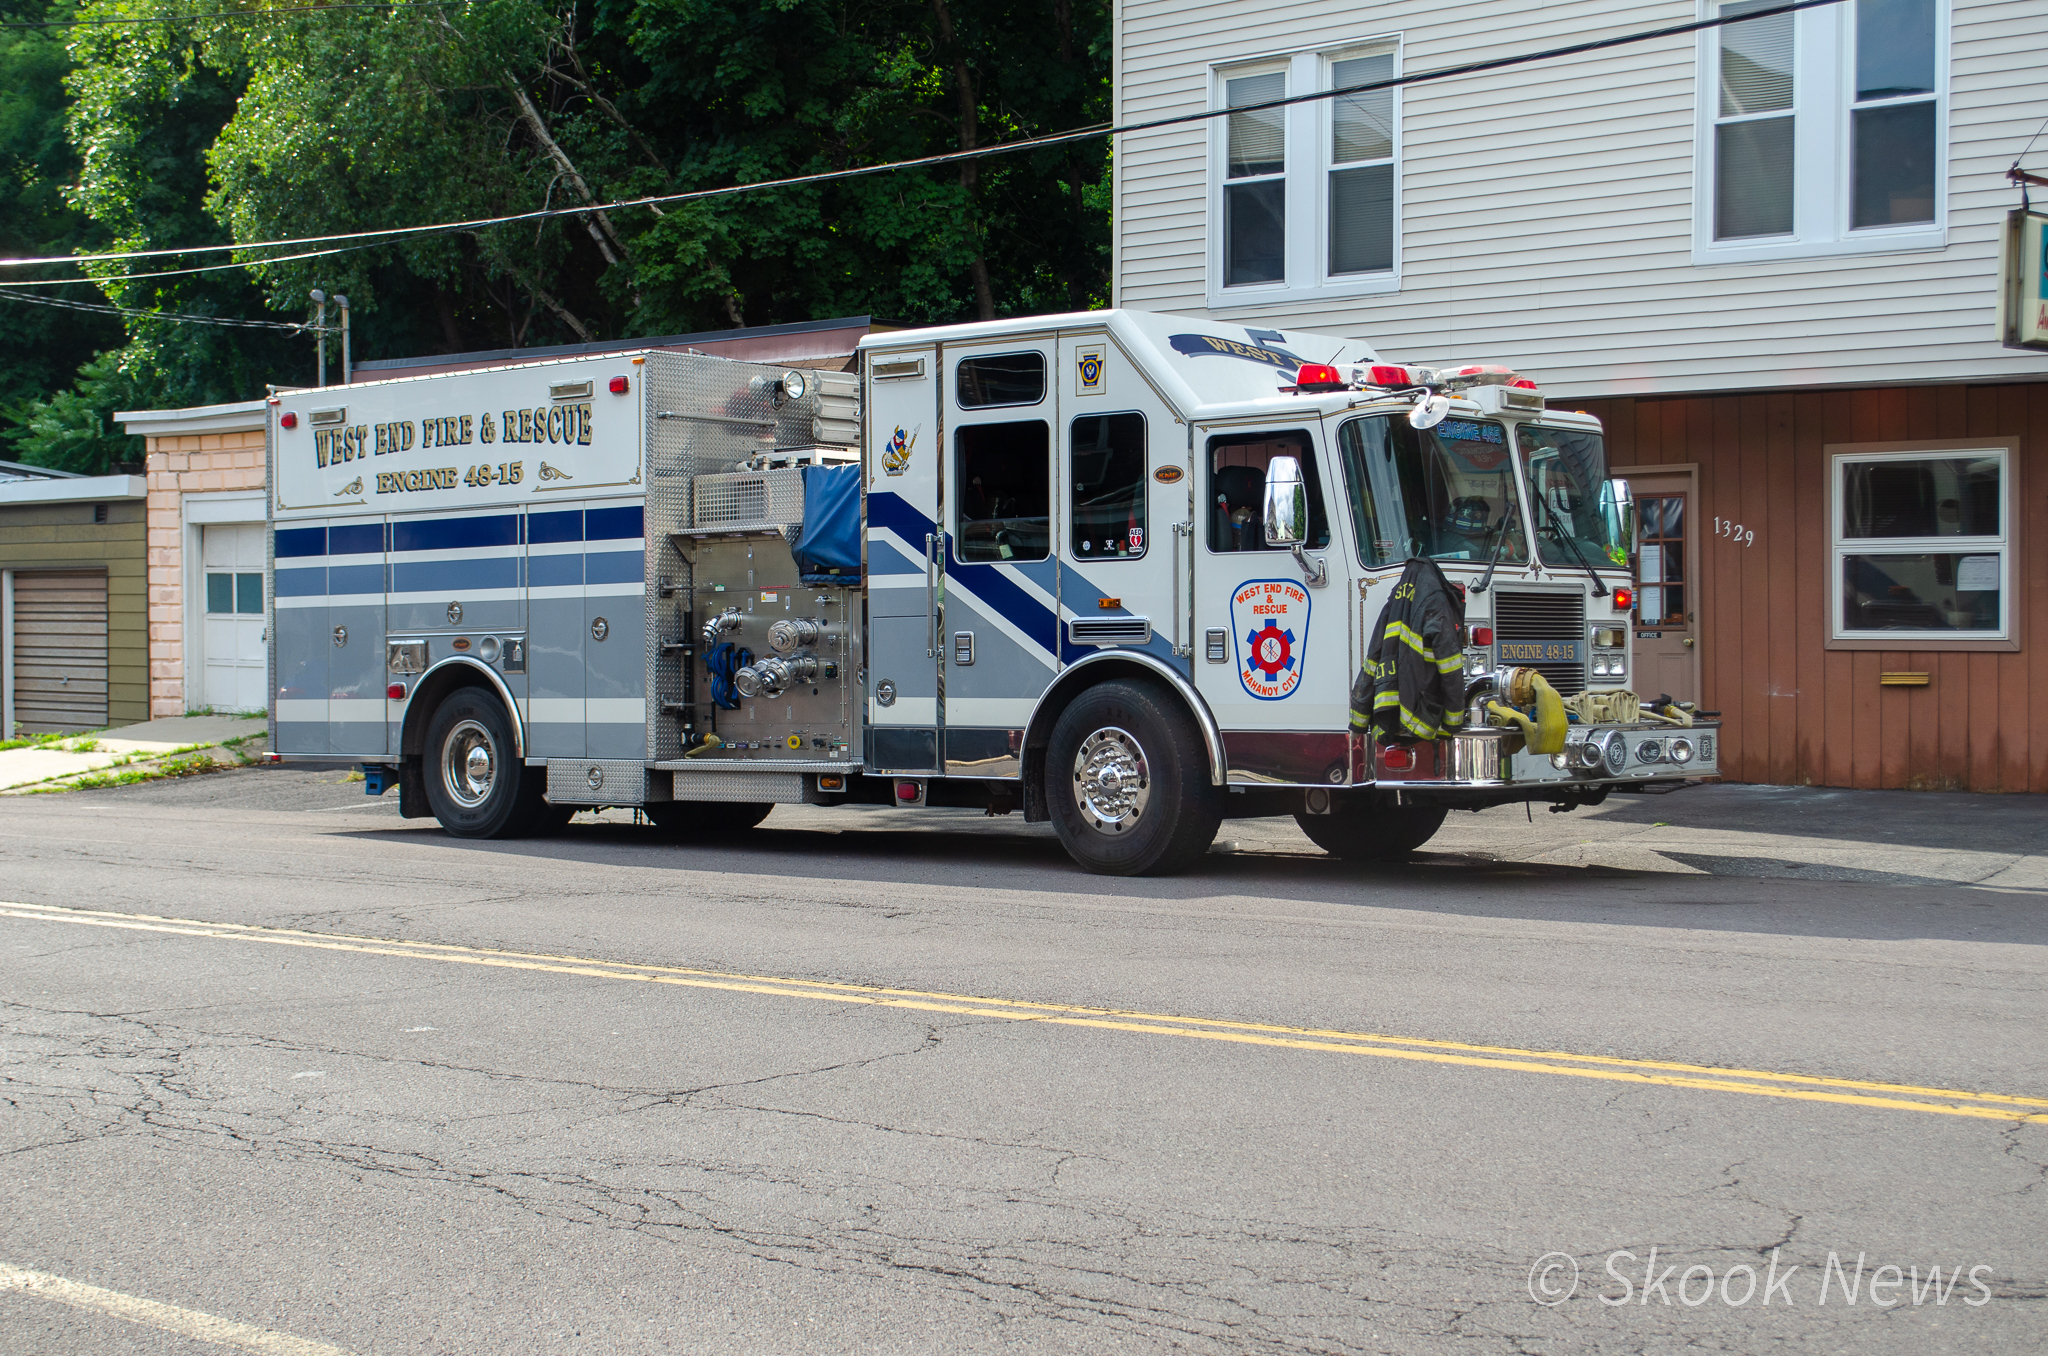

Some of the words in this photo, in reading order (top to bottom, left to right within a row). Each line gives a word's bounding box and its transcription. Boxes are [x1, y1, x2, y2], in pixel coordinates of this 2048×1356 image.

[1202, 336, 1284, 366] WEST
[314, 425, 368, 469] WEST
[375, 420, 415, 455] END
[422, 414, 474, 448] FIRE
[480, 412, 496, 444] &
[503, 403, 594, 446] RESCUE
[1437, 420, 1481, 442] ENGINE
[1482, 424, 1502, 444] 465
[376, 467, 459, 494] ENGINE
[464, 461, 525, 487] 48-15
[1713, 516, 1754, 548] 1329
[1235, 585, 1261, 604] WEST
[1263, 584, 1282, 593] END
[1285, 586, 1305, 603] FIRE
[1266, 594, 1274, 604] &
[1253, 604, 1288, 614] RESCUE
[1501, 644, 1543, 659] ENGINE
[1546, 644, 1574, 659] 48-15
[1241, 670, 1279, 696] MAHANOY
[1282, 670, 1299, 691] CITY
